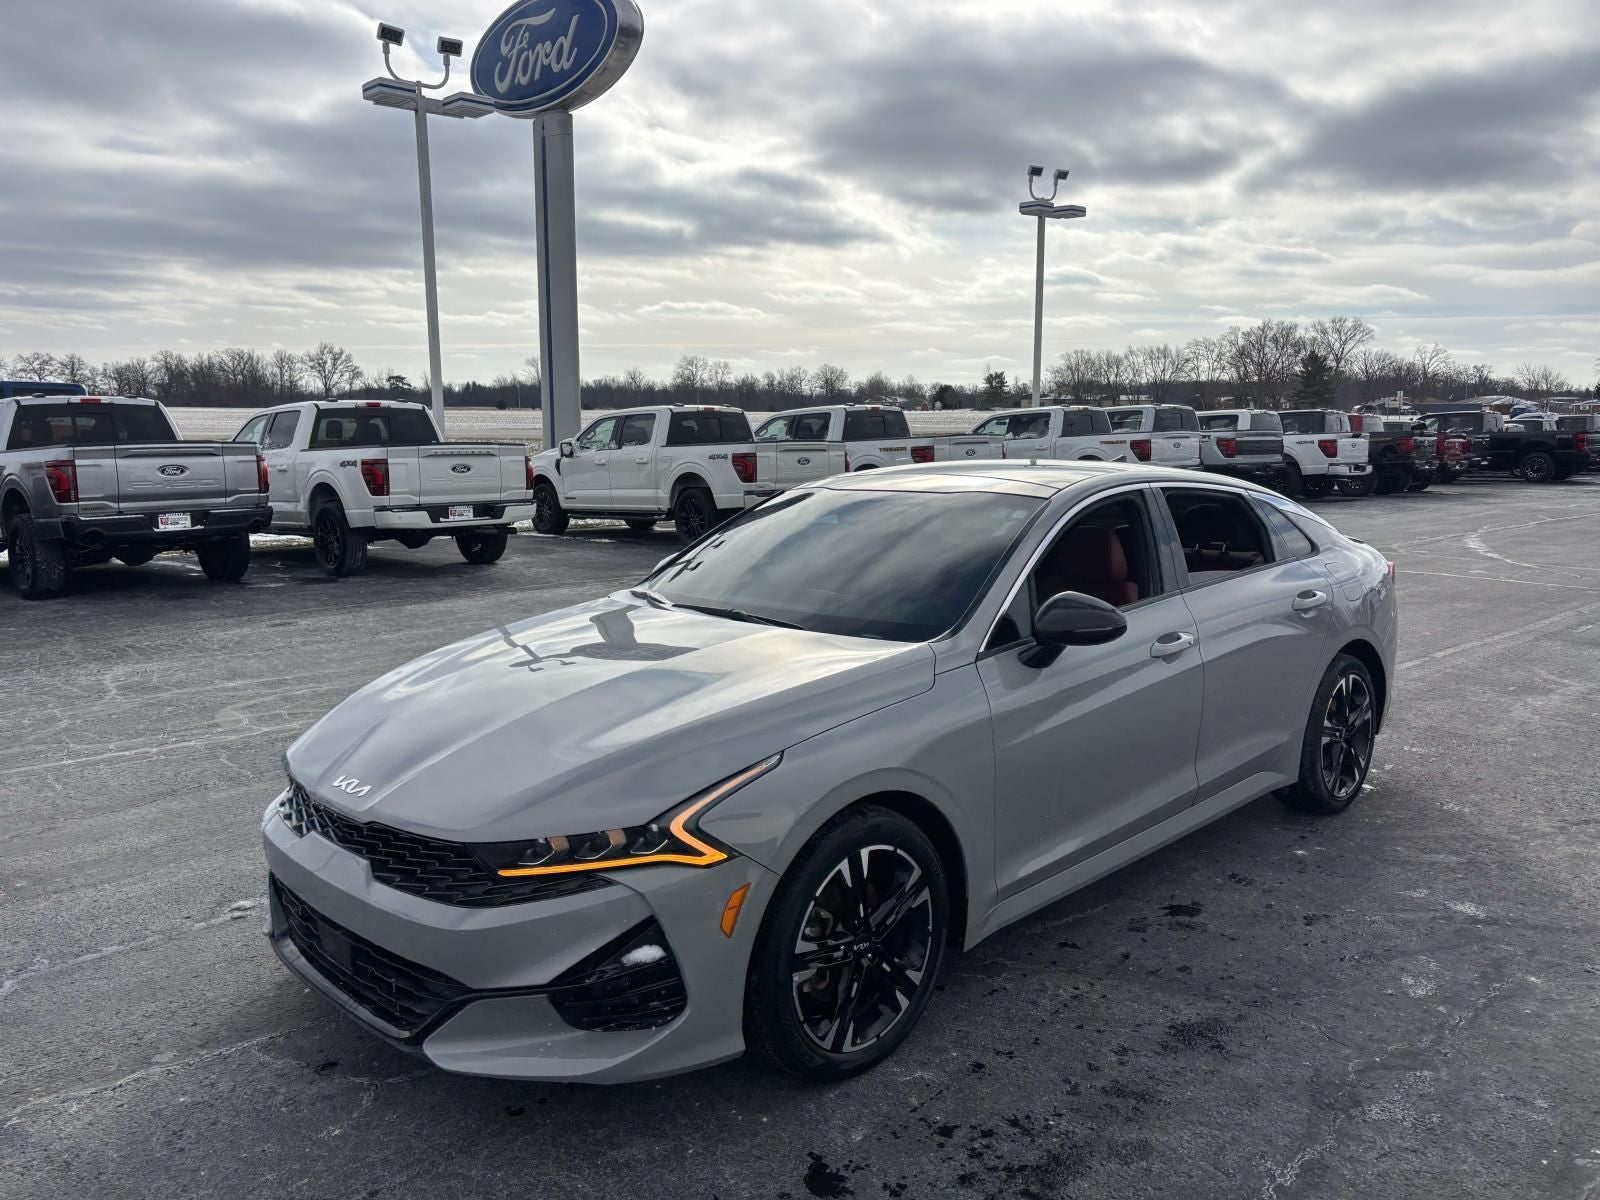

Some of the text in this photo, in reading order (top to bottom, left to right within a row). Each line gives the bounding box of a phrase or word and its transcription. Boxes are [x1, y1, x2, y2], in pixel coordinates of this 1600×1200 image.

[495, 8, 579, 94] Ford
[164, 466, 181, 475] Ford
[332, 775, 372, 797] KIA
